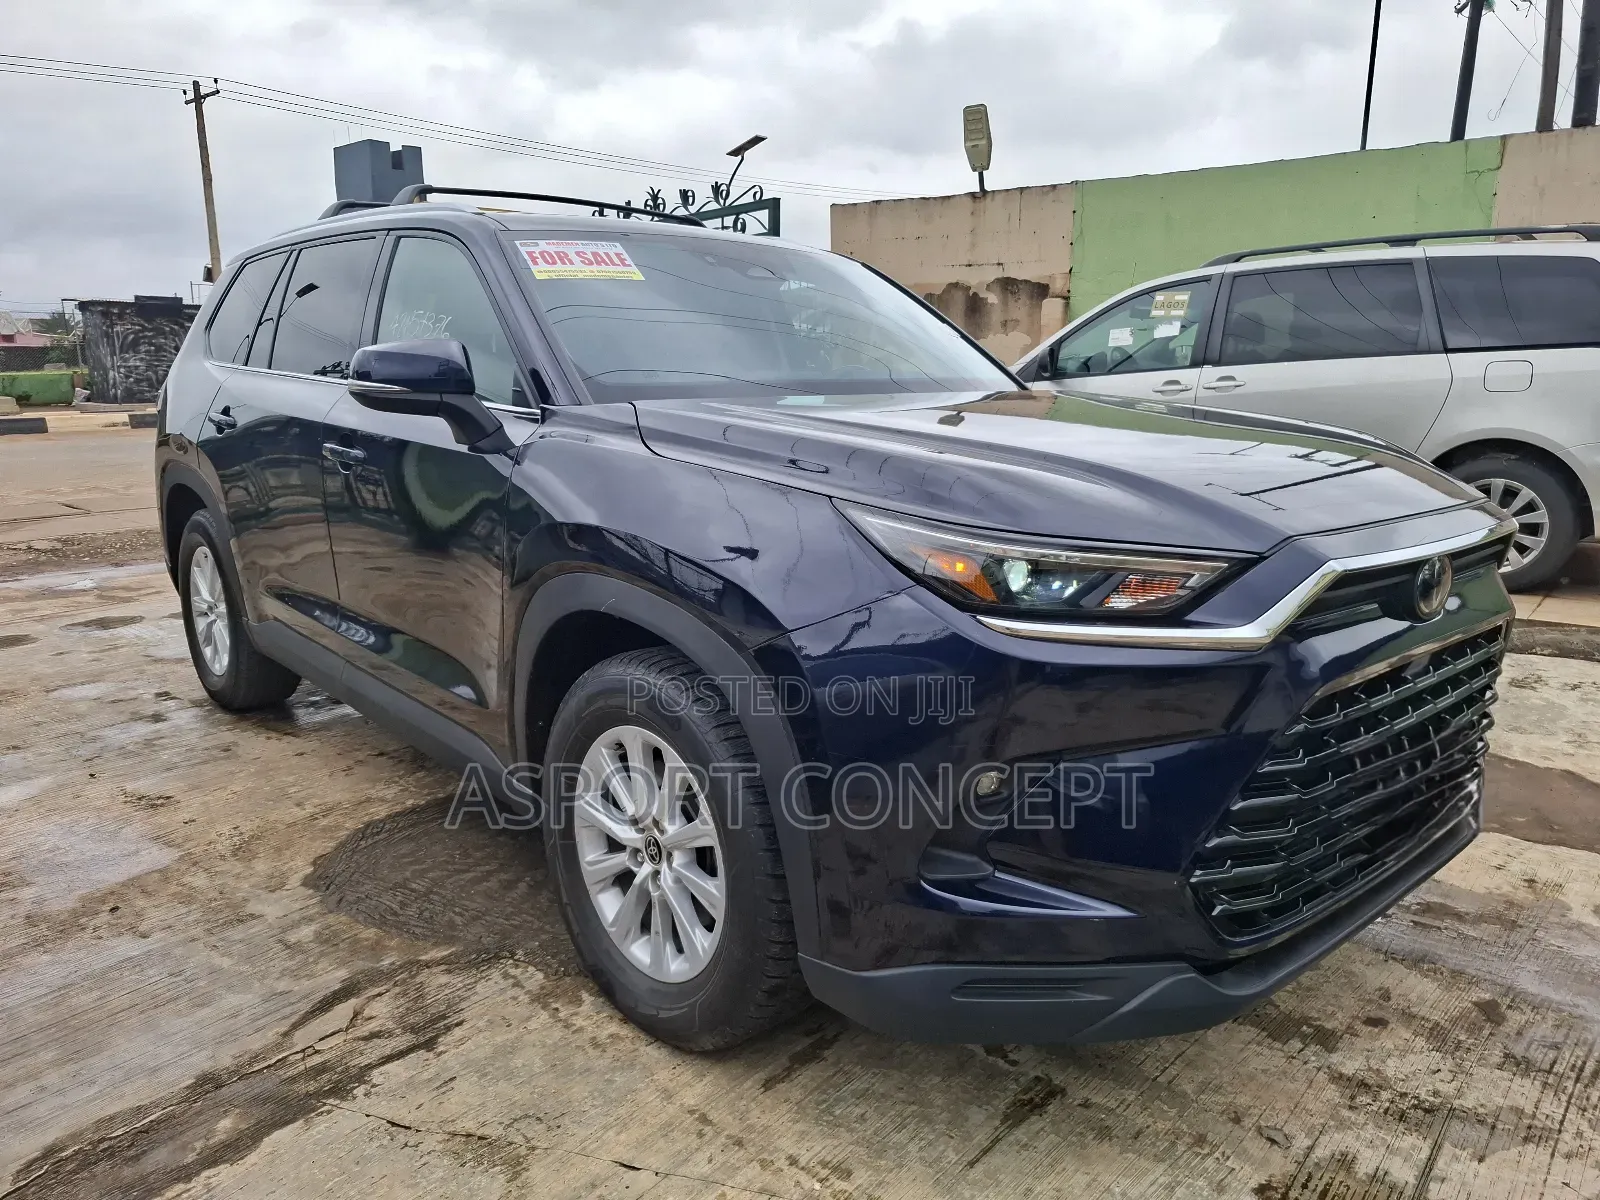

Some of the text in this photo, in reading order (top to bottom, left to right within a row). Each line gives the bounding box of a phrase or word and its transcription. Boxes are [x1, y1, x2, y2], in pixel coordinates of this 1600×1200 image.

[525, 250, 632, 267] FOR SALE
[1154, 301, 1186, 309] LAGOS
